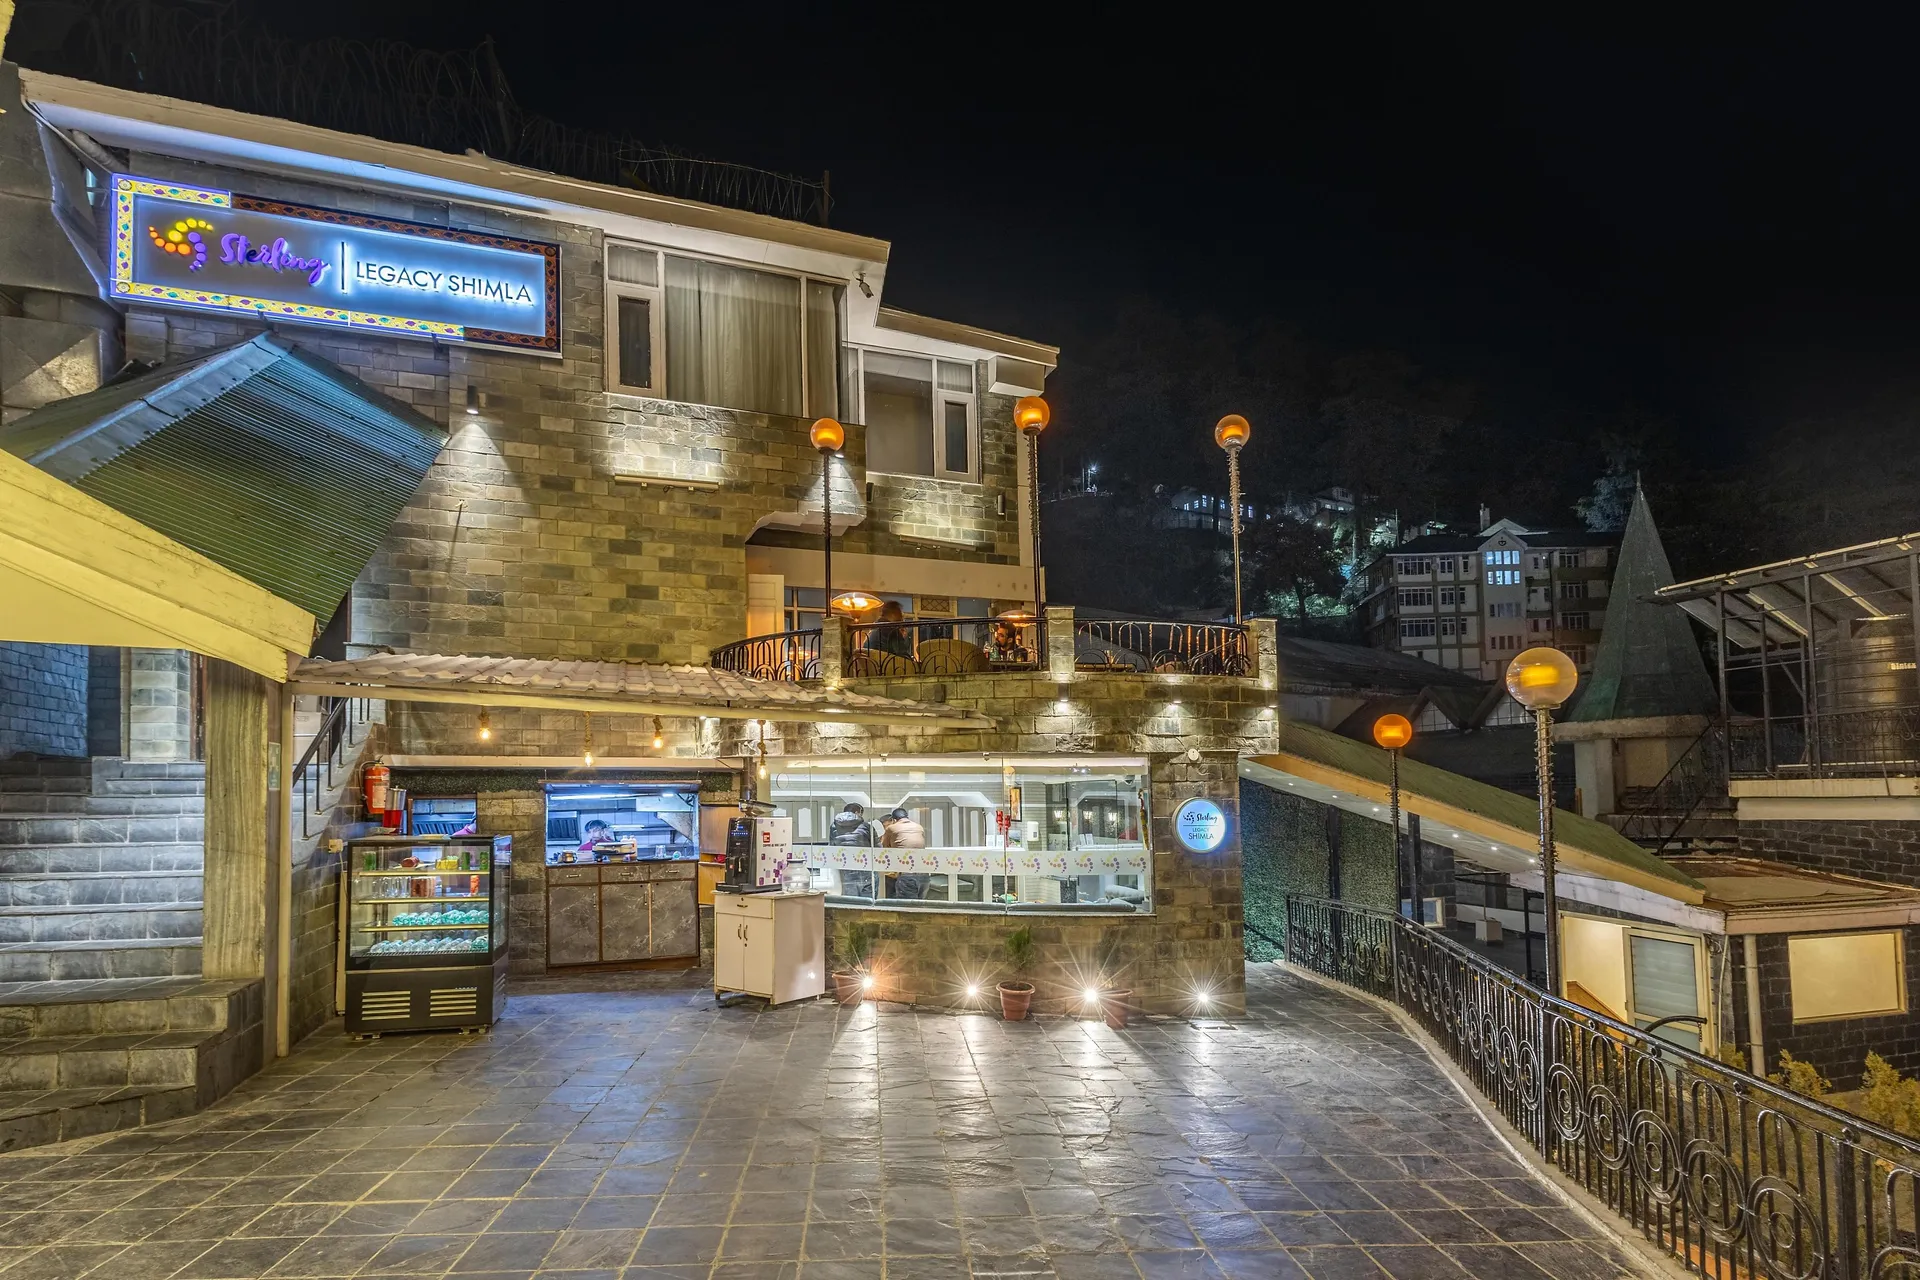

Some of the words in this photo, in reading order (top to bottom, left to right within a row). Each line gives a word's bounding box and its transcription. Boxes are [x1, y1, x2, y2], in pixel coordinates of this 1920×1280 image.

[220, 233, 329, 285] Sterling
[356, 260, 442, 288] LEGACY
[448, 274, 532, 302] SHIMLA
[1197, 812, 1217, 823] Sterling
